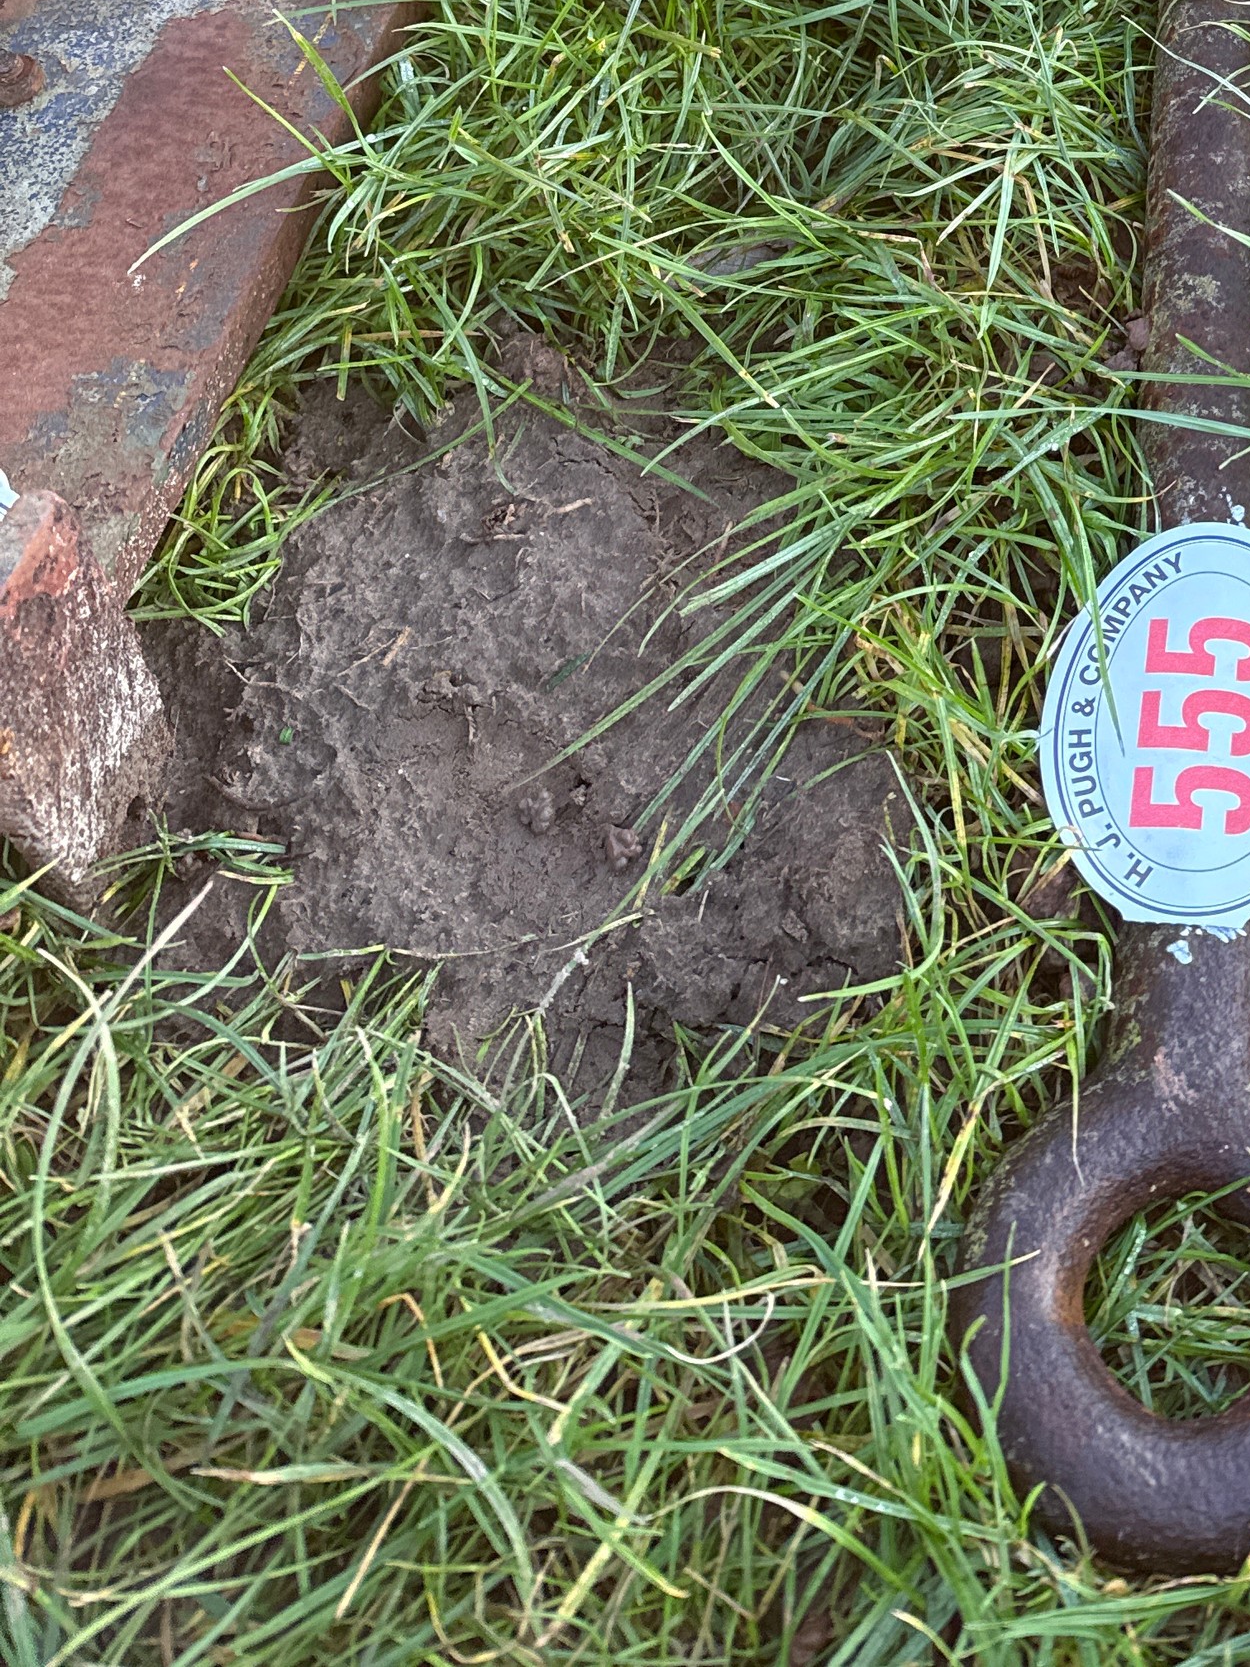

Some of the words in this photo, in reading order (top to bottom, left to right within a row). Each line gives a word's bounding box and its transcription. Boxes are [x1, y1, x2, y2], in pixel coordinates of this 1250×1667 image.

[1079, 551, 1184, 686] COMPANY
[1072, 700, 1095, 717] &
[1068, 728, 1104, 818] PUGH
